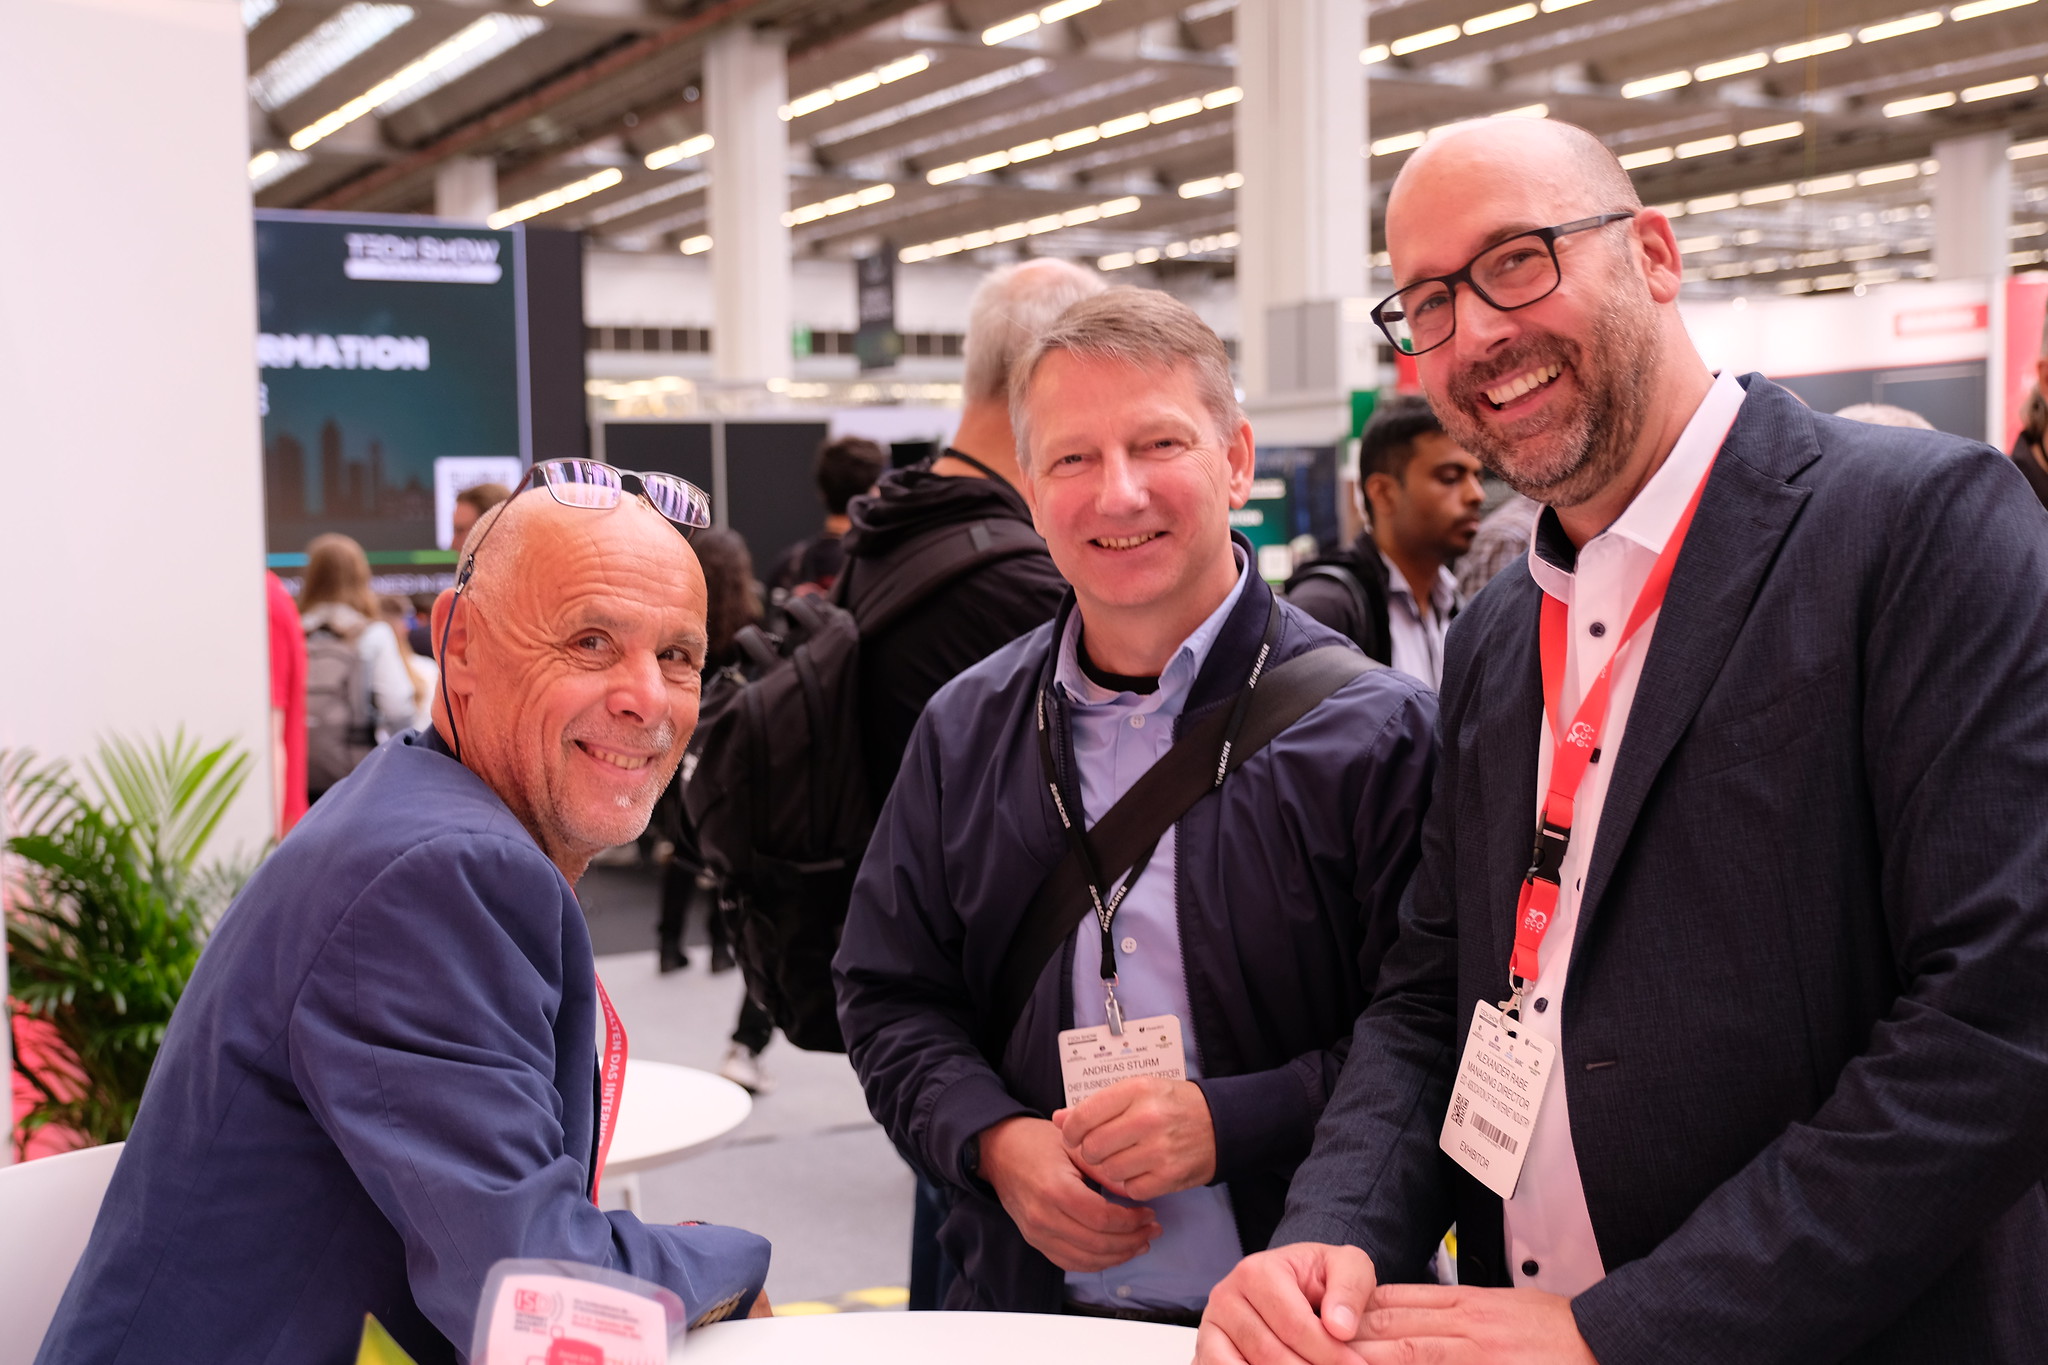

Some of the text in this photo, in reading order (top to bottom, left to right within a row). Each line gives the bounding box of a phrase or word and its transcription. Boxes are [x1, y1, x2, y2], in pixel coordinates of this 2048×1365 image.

[1248, 643, 1270, 688] JENBACHER
[1103, 885, 1128, 933] JENBACHER
[608, 1054, 621, 1080] DAS
[1082, 1063, 1125, 1076] ANDREAS
[1128, 1058, 1160, 1070] STURM
[1084, 1078, 1112, 1090] BUSINESS
[1154, 1069, 1181, 1079] OFFICER
[1476, 1050, 1510, 1079] ALEXANDER
[1510, 1072, 1528, 1092] RABE
[1467, 1061, 1530, 1111] MANAGING DIRECTOR
[1459, 1140, 1490, 1170] EXHIBITOR
